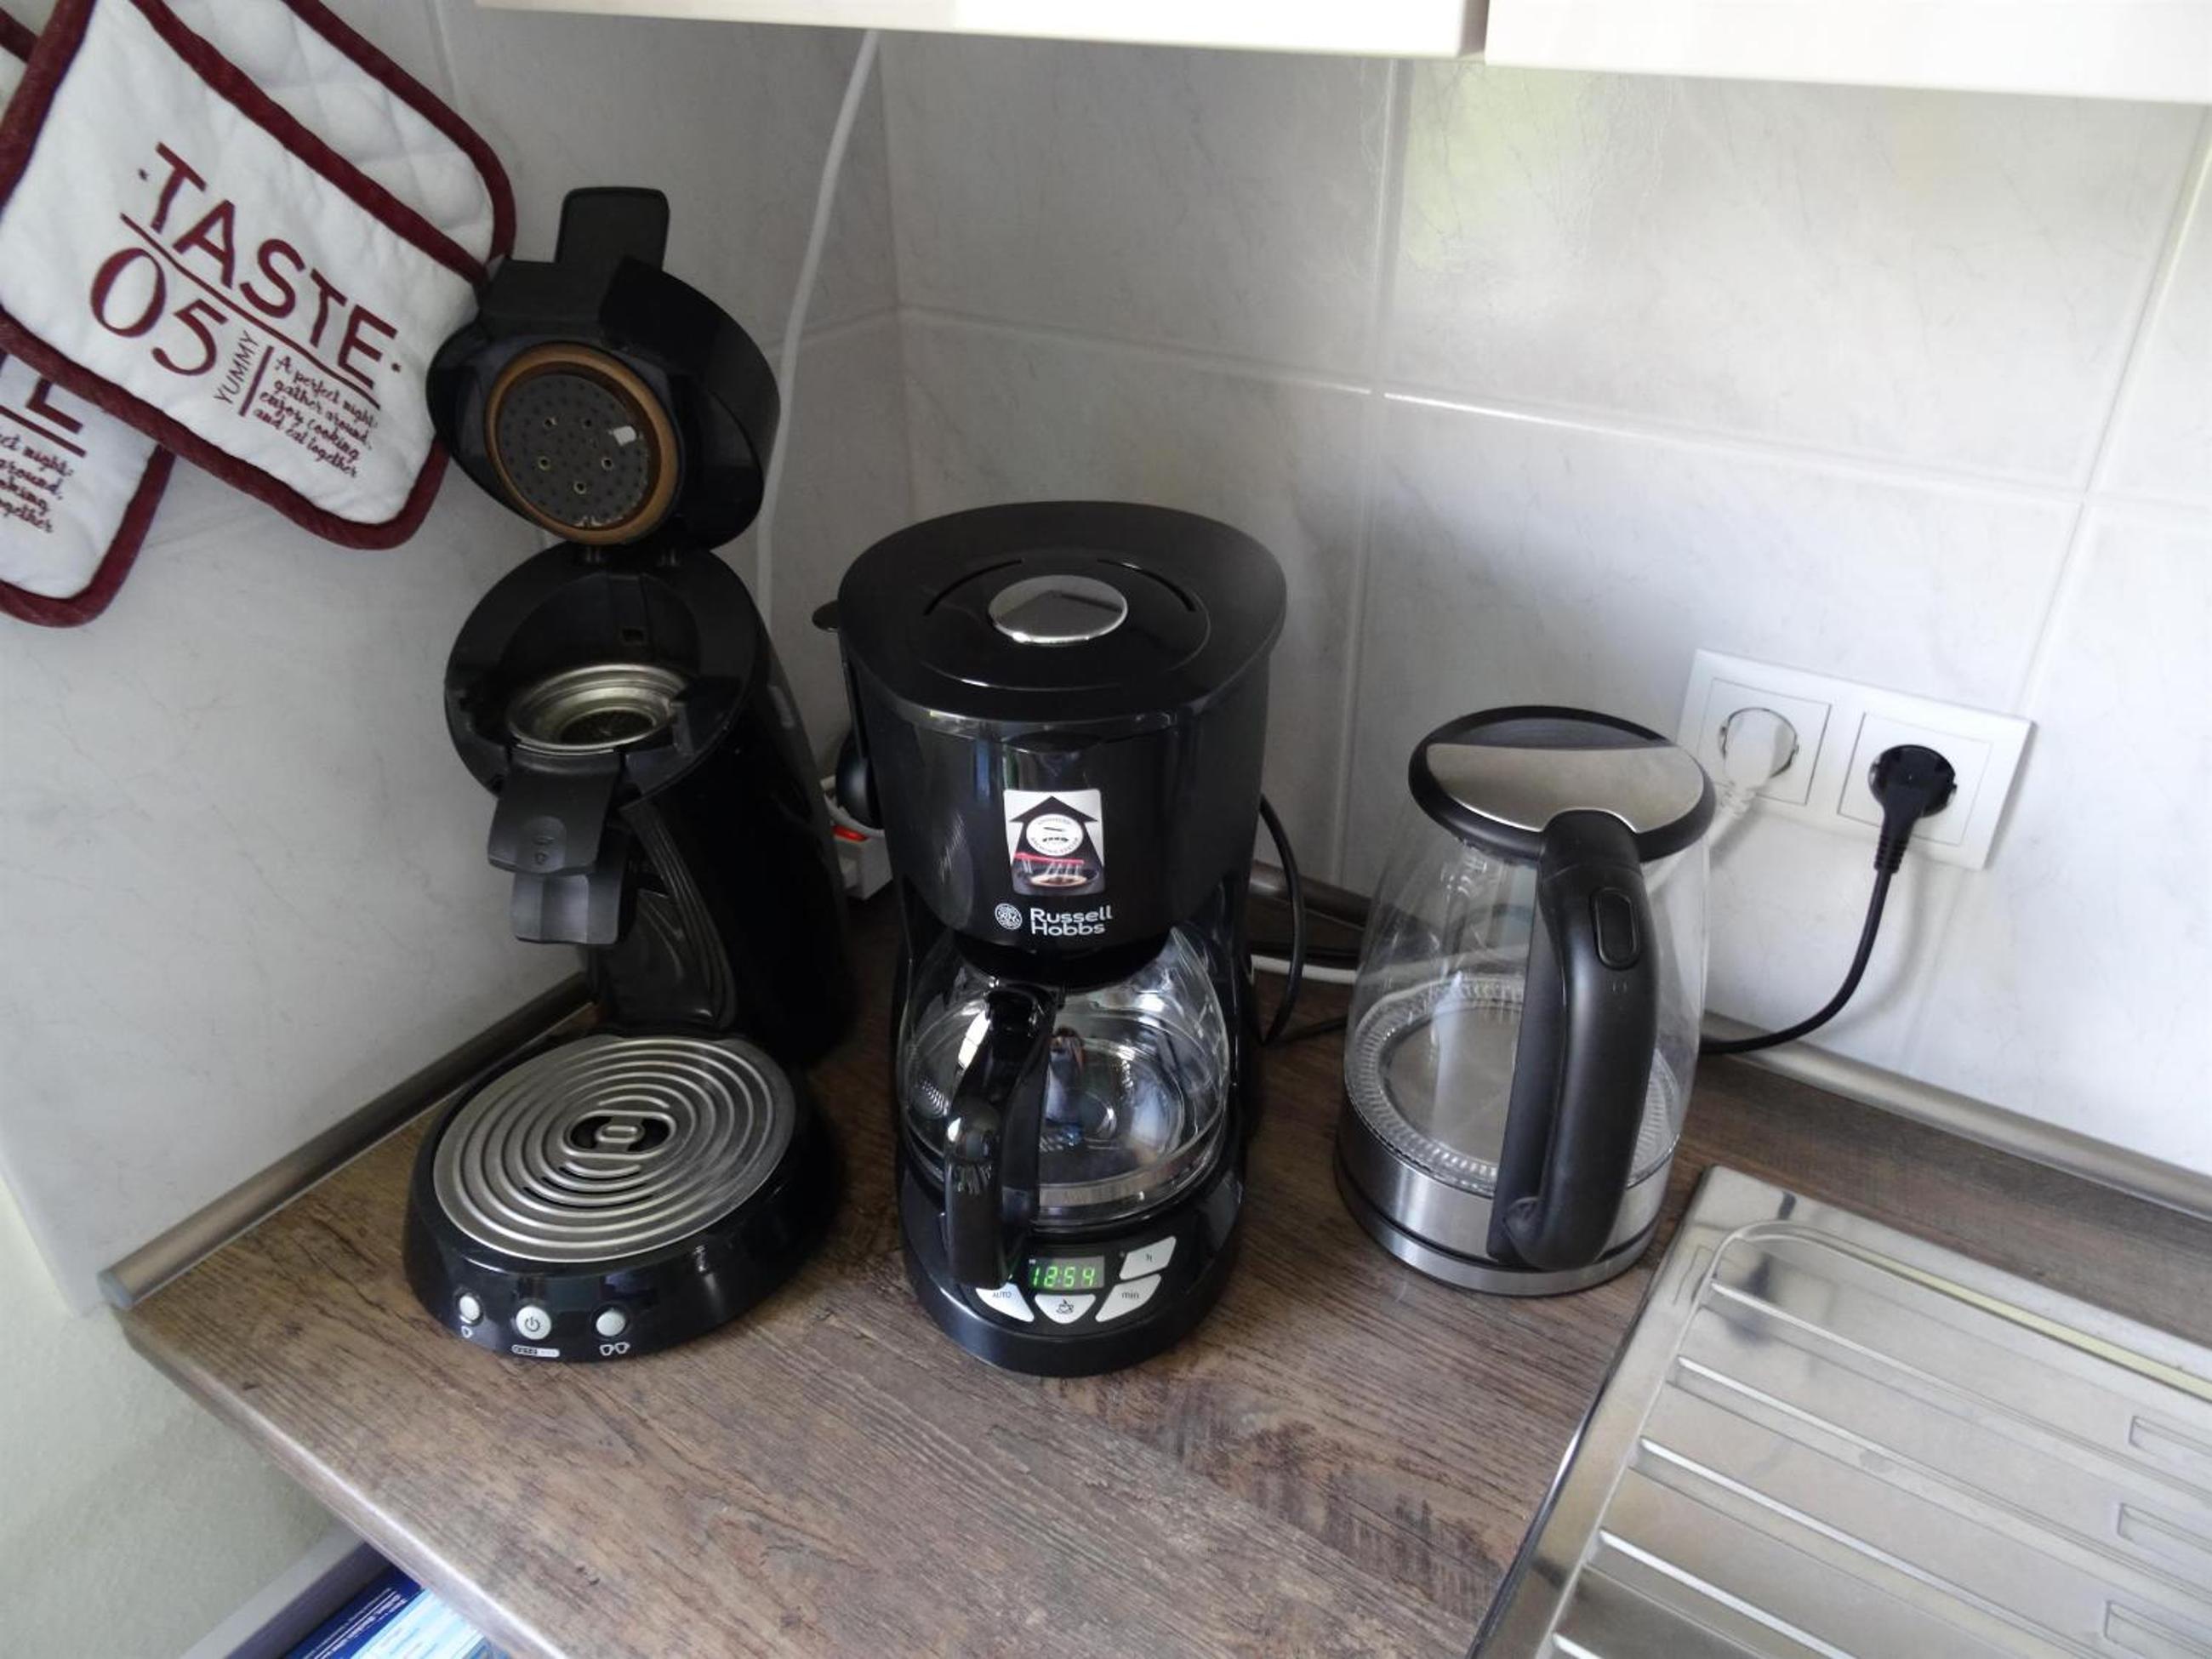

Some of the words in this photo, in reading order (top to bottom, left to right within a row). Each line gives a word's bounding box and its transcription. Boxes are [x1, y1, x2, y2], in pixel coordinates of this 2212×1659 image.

[150, 141, 399, 390] TASTE
[89, 247, 229, 376] 05
[213, 329, 259, 405] YUMMY
[273, 379, 322, 415] gather
[275, 356, 292, 374] A
[293, 370, 339, 404] perfect
[254, 408, 285, 430] and
[306, 436, 357, 478] together
[259, 391, 304, 428] enjoy
[306, 418, 360, 464] cooking
[1029, 904, 1114, 924] Russell
[1030, 921, 1106, 937] Hobbs
